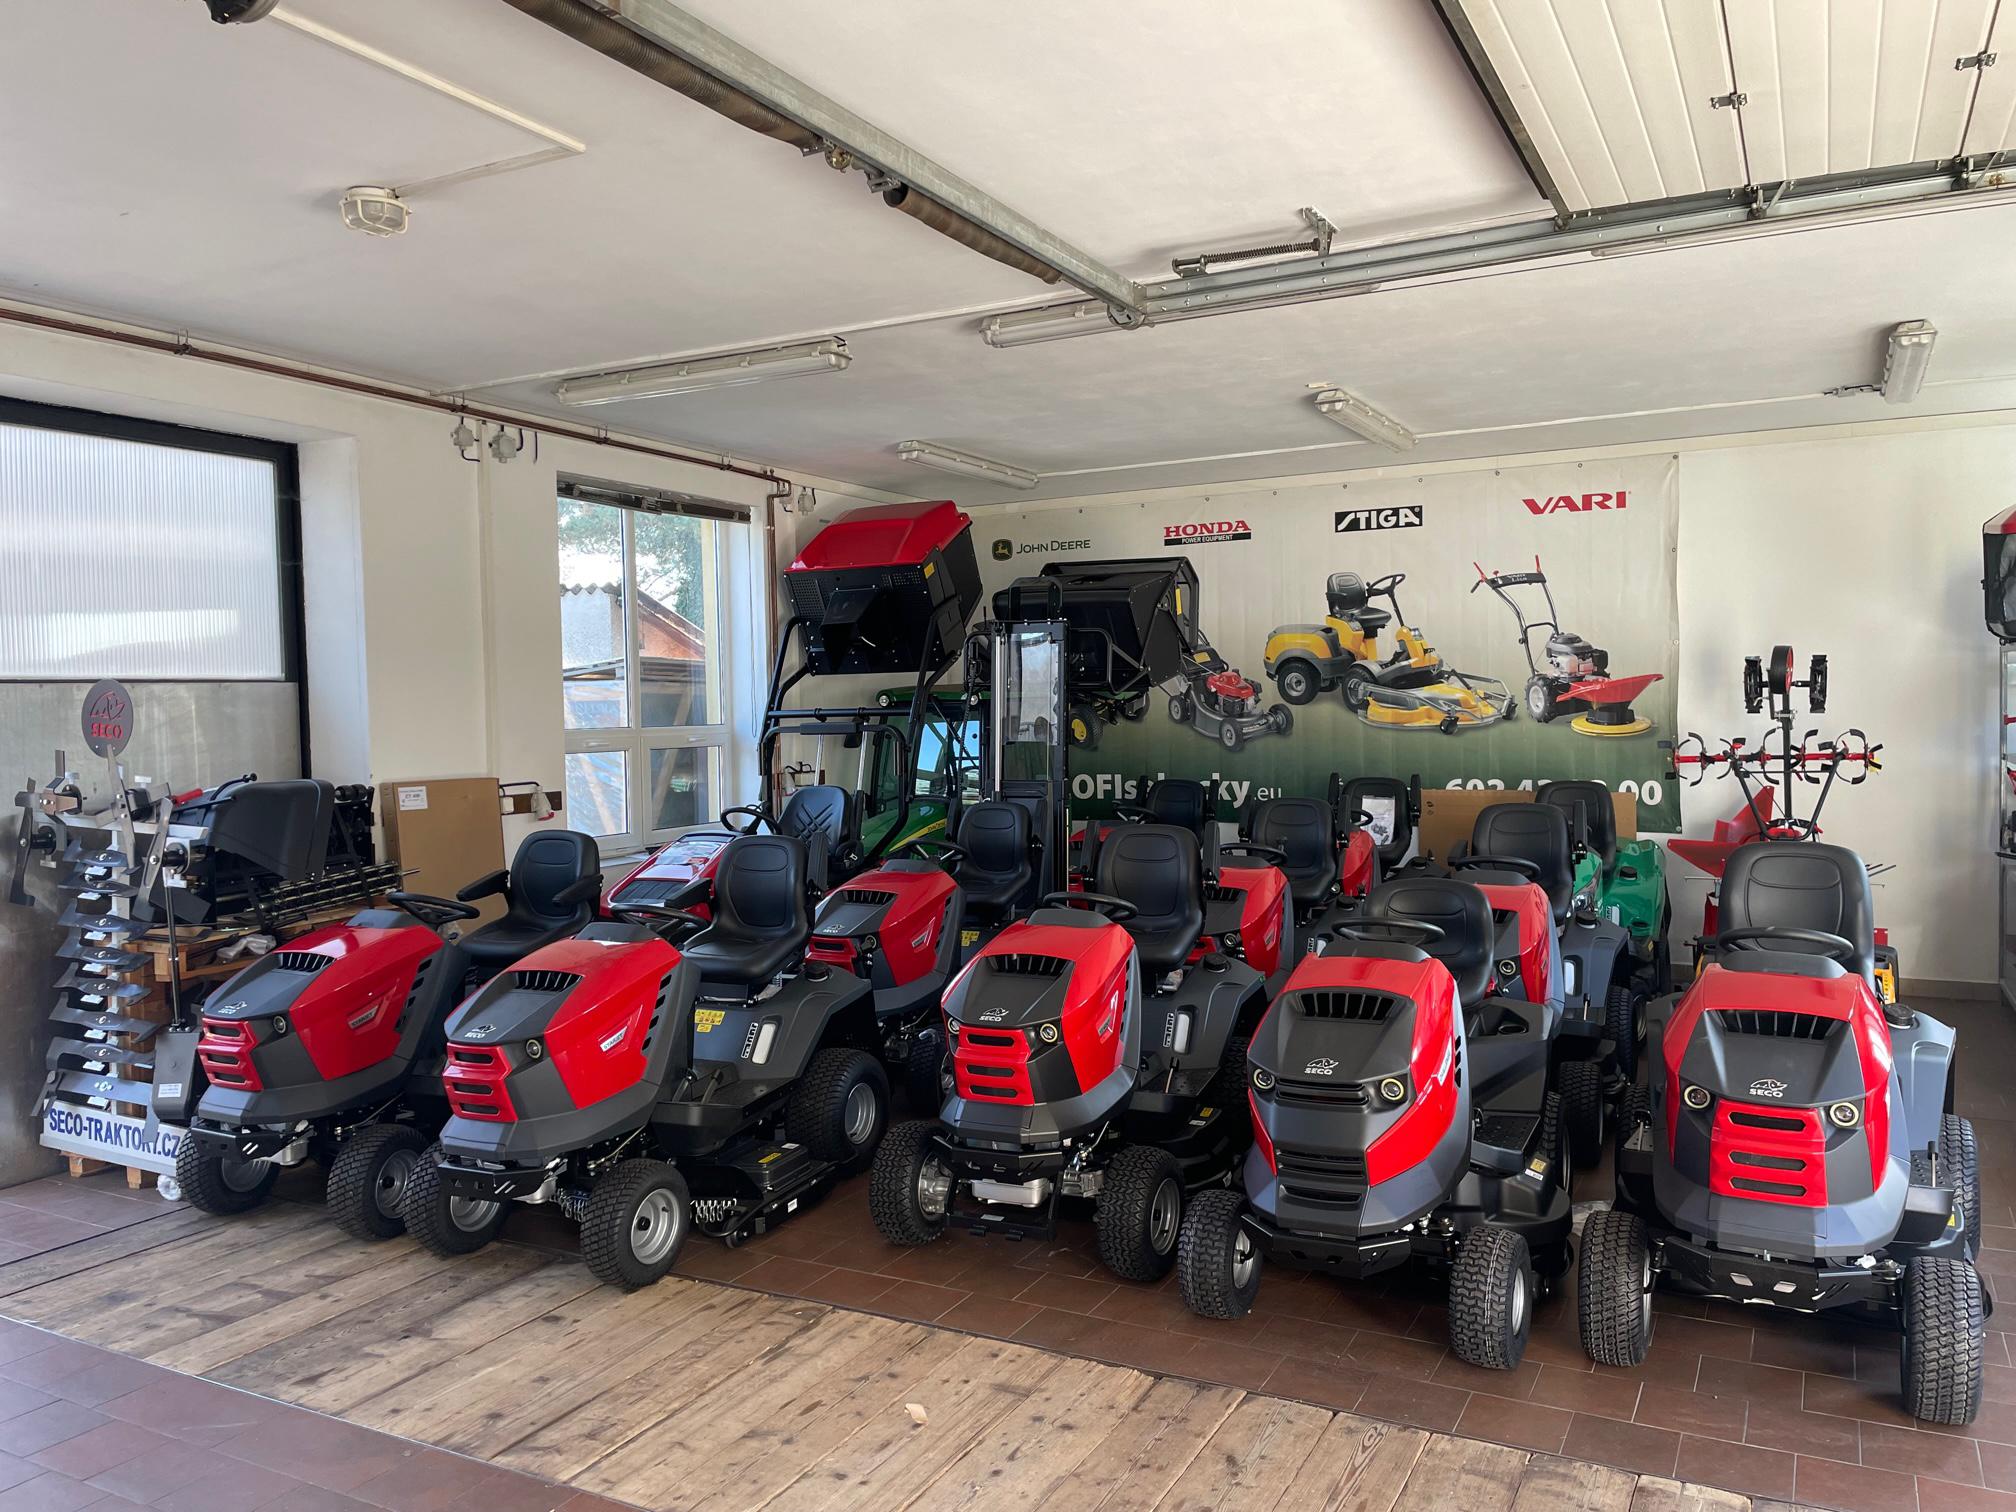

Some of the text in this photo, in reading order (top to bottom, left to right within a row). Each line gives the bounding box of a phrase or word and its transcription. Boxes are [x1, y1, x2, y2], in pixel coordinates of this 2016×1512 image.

[1522, 491, 1627, 515] VARI
[1337, 507, 1420, 531] STIGA
[1163, 520, 1251, 537] HONDA
[1016, 540, 1091, 554] JOHN DEERE
[1181, 534, 1233, 545] POWER EQUIPMENT
[91, 722, 123, 740] SECO
[1304, 1067, 1333, 1076] SECO
[1749, 1088, 1784, 1098] SECO
